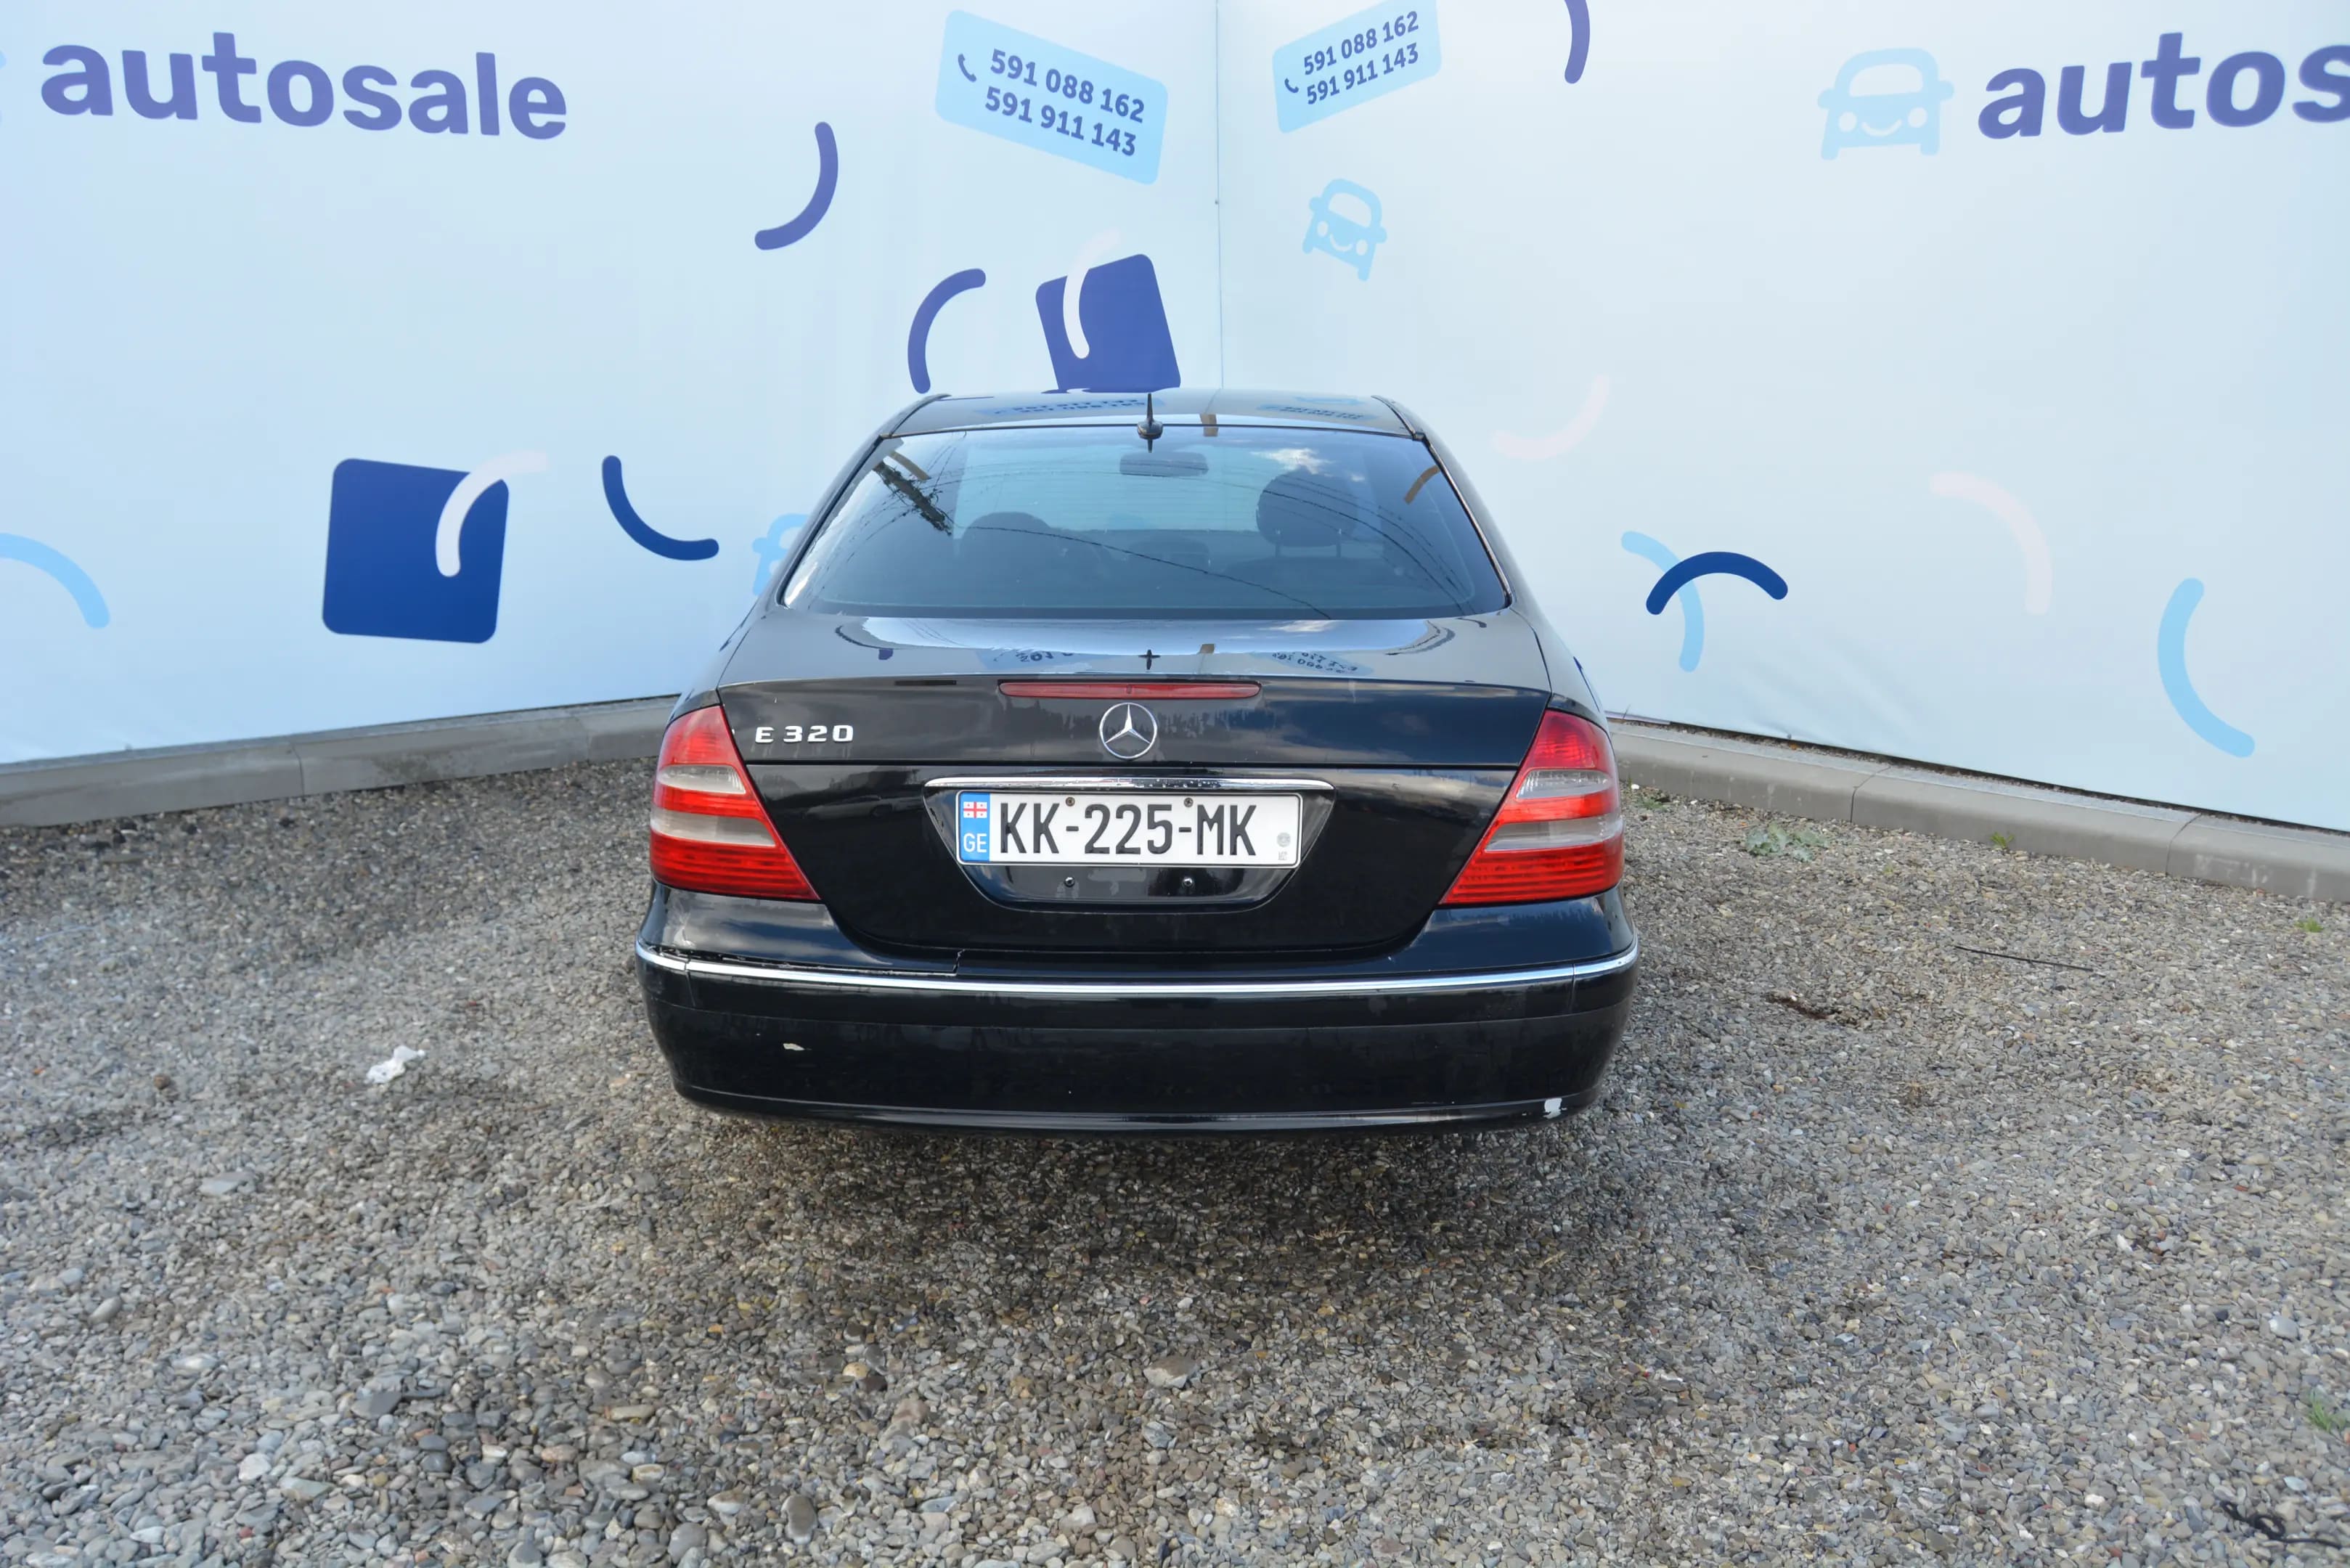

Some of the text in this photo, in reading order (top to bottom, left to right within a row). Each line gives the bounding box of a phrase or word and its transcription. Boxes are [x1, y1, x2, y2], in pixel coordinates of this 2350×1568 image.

[1303, 10, 1419, 76] 591 088 162
[1306, 41, 1419, 106] 591 911 143
[40, 30, 568, 141] autosale
[990, 48, 1146, 125] 591 088 162
[1977, 31, 2350, 139] autos
[984, 86, 1137, 158] 591 911 143
[754, 724, 854, 743] E 320
[962, 831, 988, 854] GE
[1000, 802, 1257, 856] KK-225-MK
